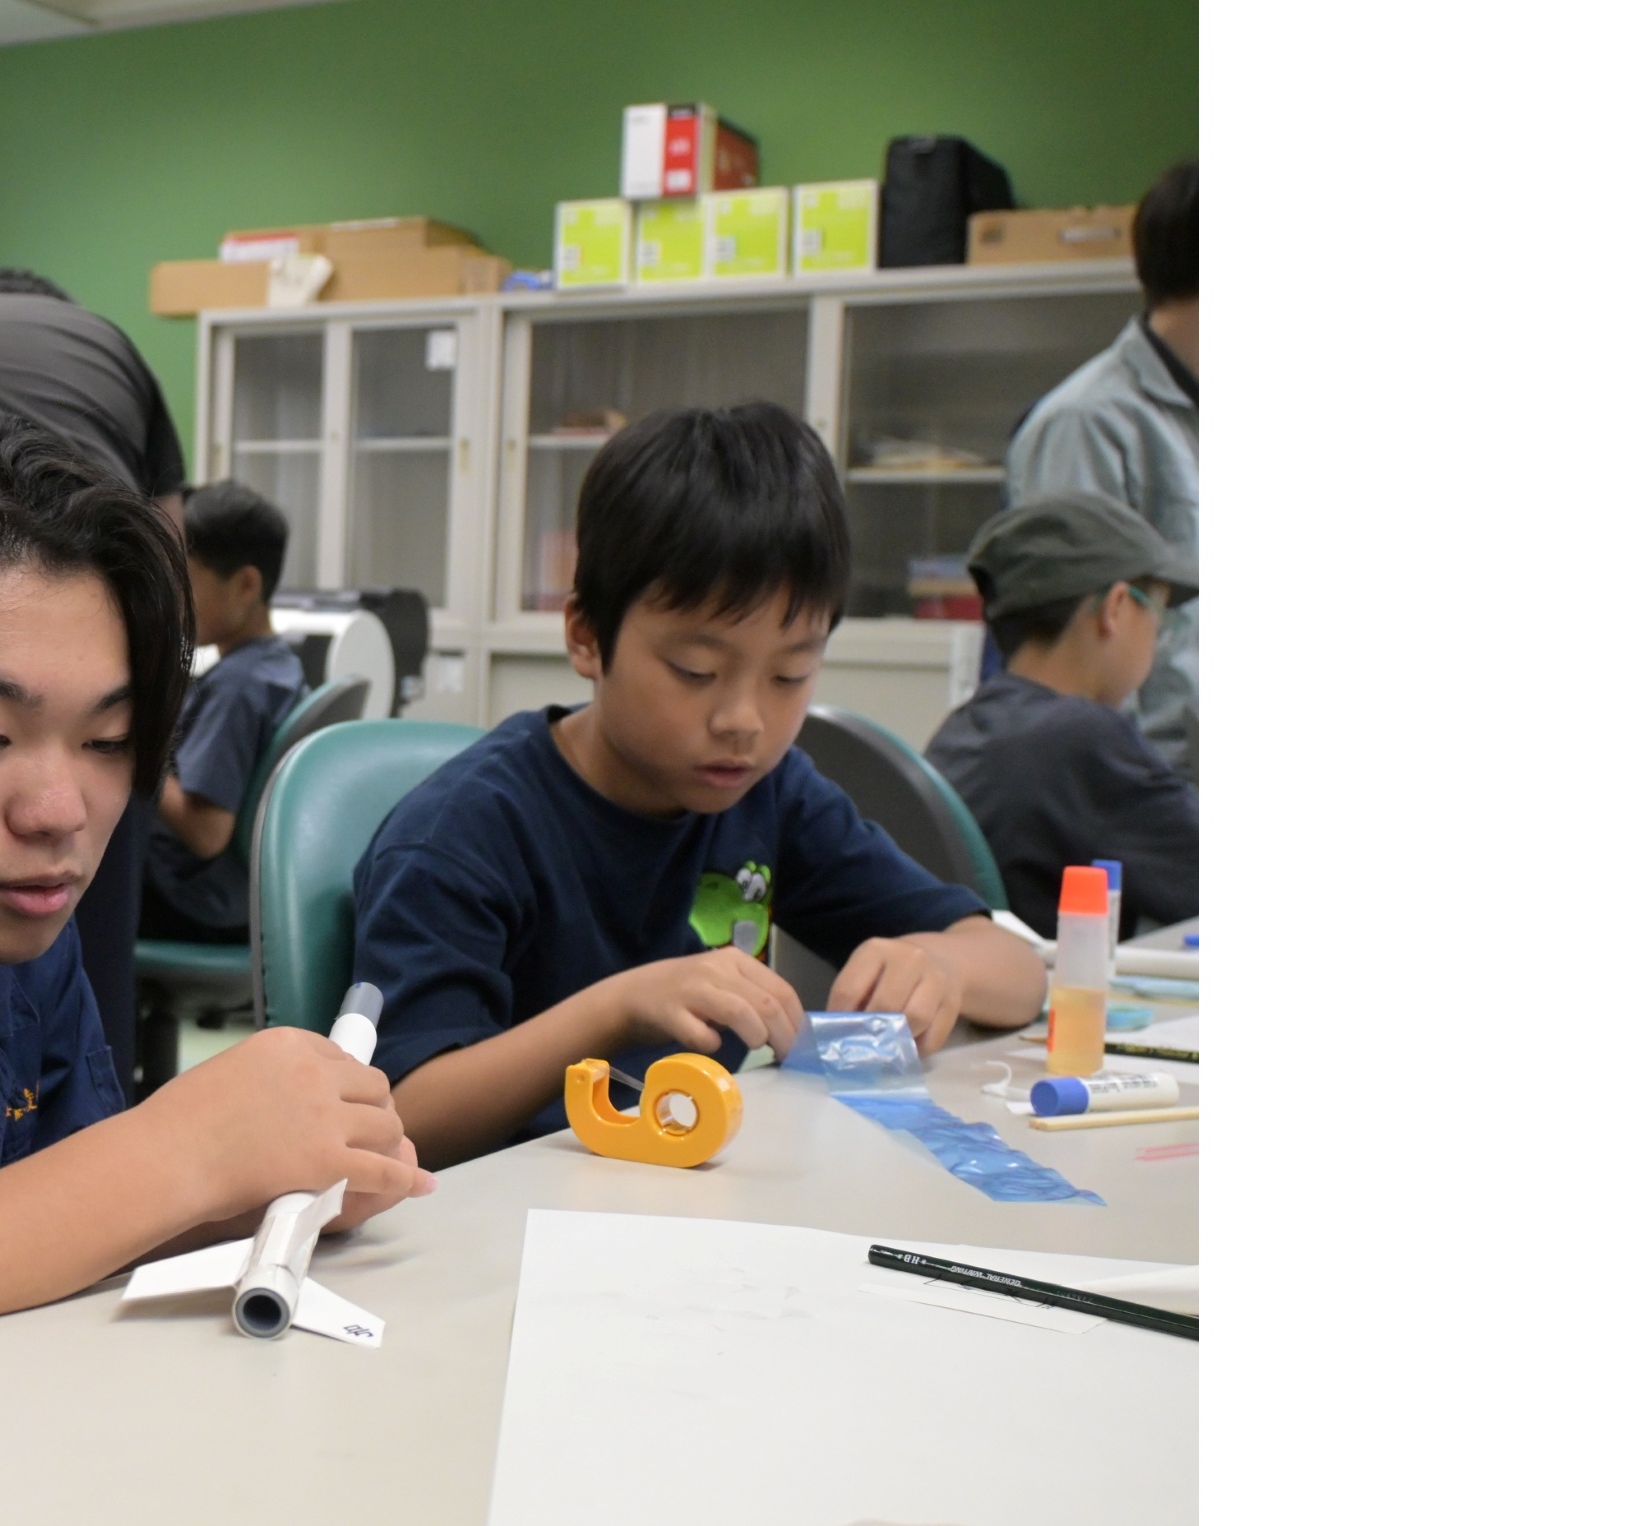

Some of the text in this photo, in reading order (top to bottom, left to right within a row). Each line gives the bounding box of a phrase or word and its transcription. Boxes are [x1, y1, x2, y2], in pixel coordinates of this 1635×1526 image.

[903, 1254, 1022, 1287] GENERAL WRITING HB
